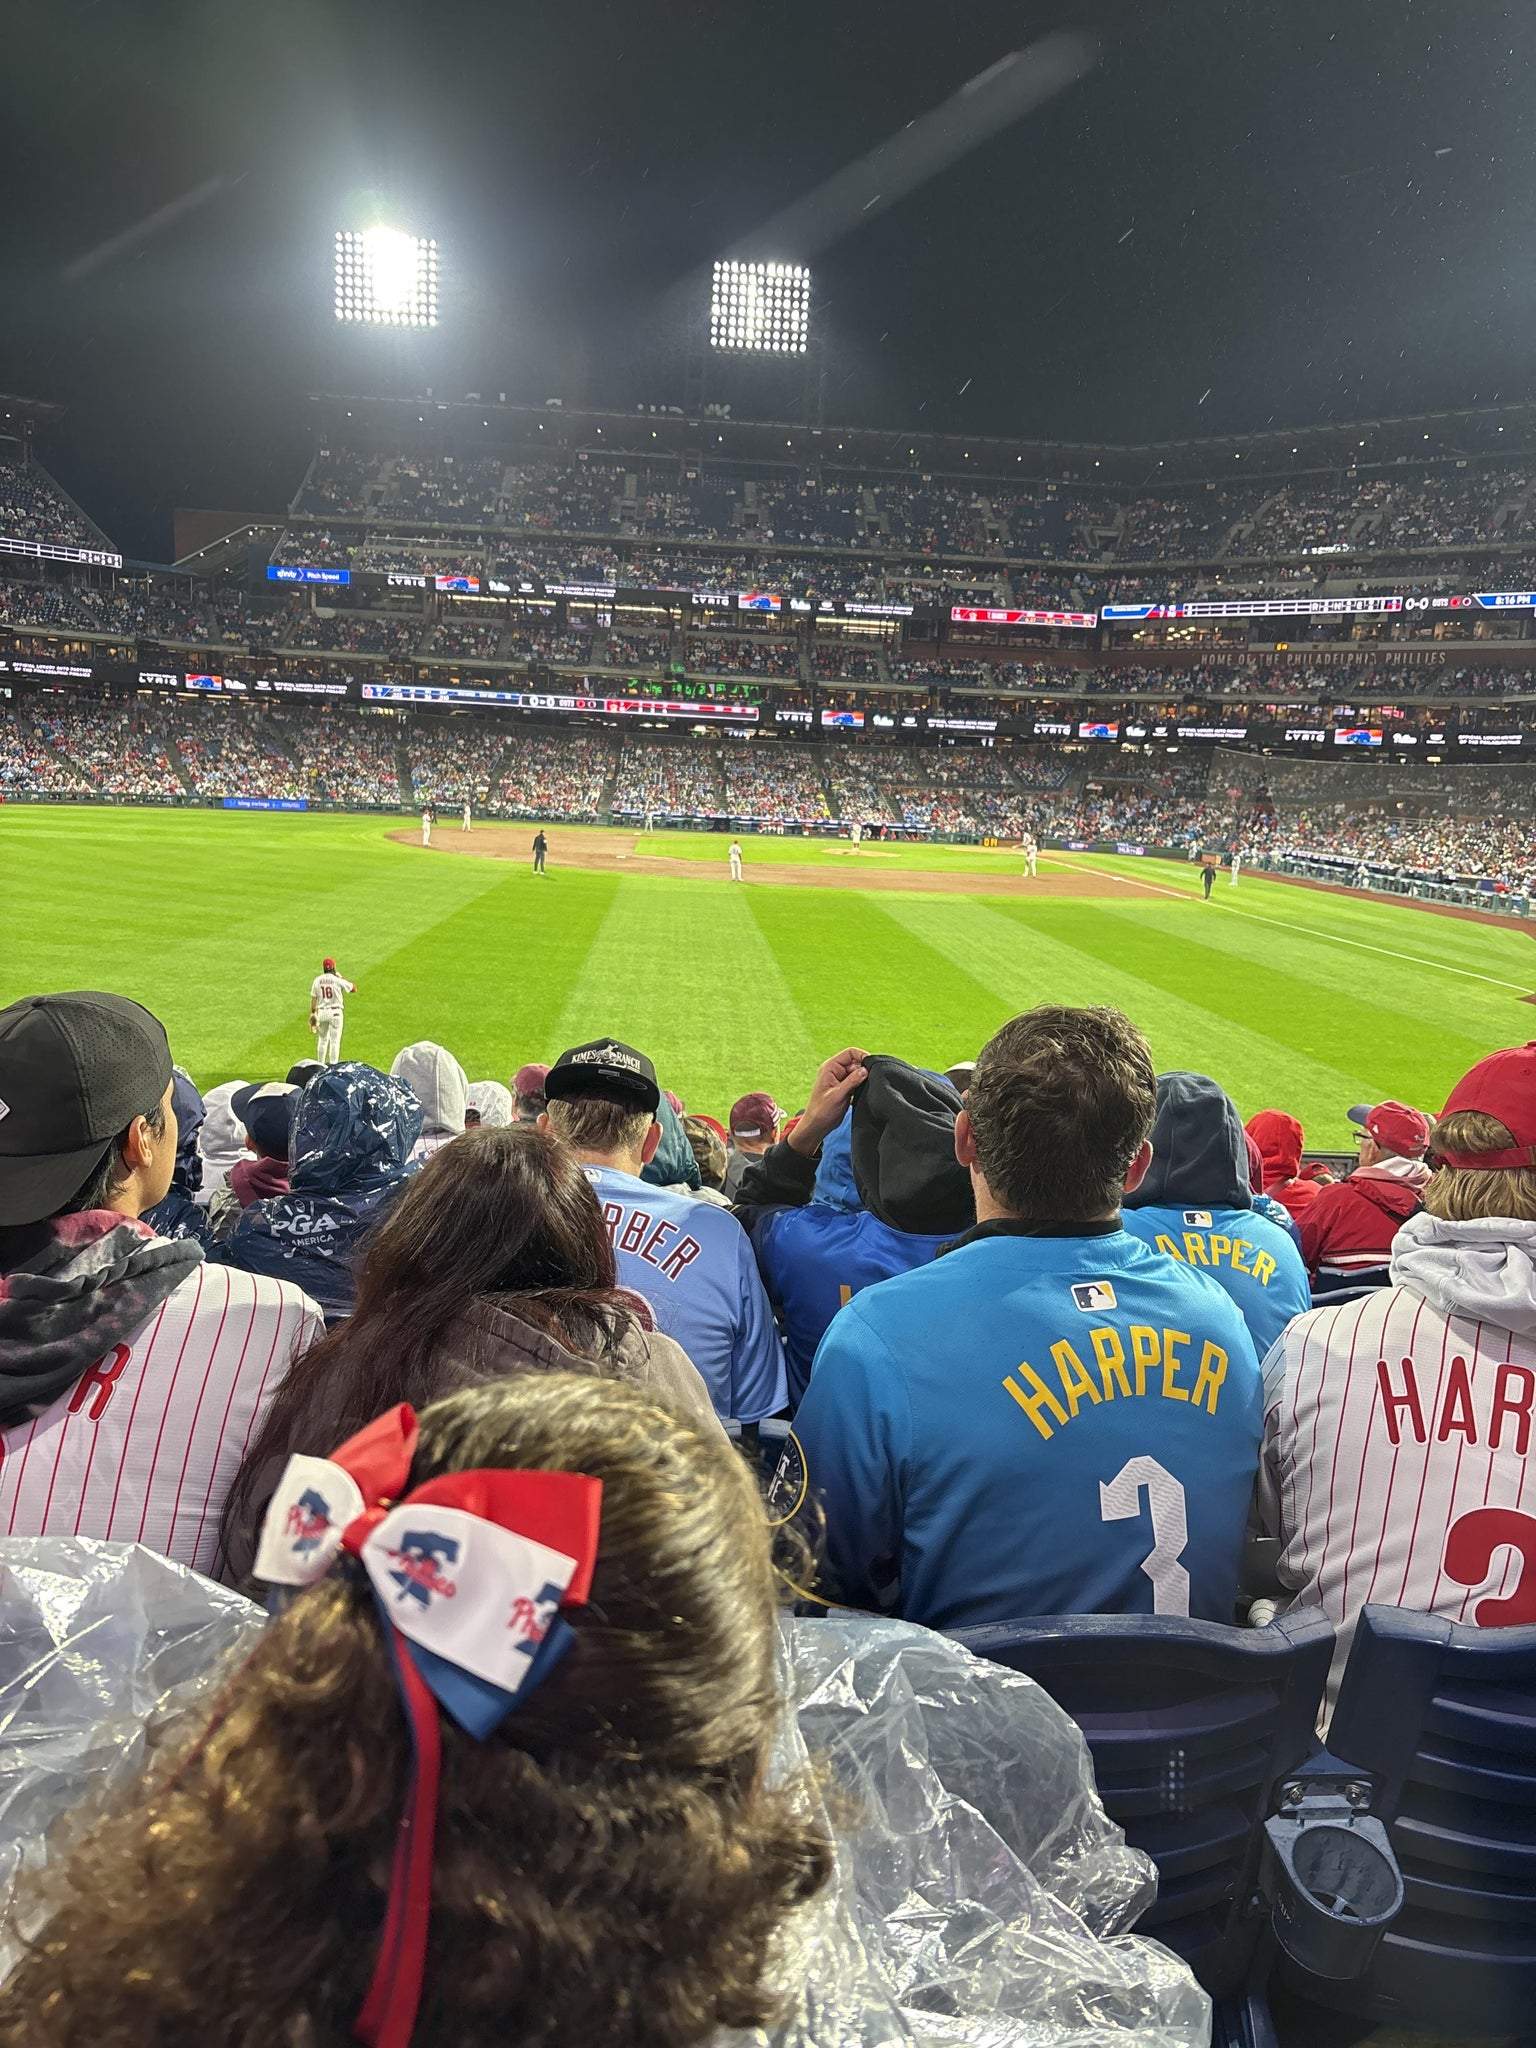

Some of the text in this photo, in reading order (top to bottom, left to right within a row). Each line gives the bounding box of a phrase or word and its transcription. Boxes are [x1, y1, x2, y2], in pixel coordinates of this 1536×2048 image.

[1405, 597, 1449, 610] 0-0 OUTS
[1495, 595, 1531, 605] 8:16 PM
[1201, 654, 1232, 666] HOME
[1239, 654, 1252, 665] OF
[1260, 653, 1280, 666] THE
[1385, 652, 1446, 665] PHILLIES
[529, 695, 555, 707] 0-0
[571, 1049, 641, 1070] KIMES RANCH
[270, 1213, 341, 1238] PGA
[291, 1234, 335, 1247] AMERICA
[66, 1342, 132, 1423] R
[1002, 1325, 1229, 1441] HARPER
[1376, 1355, 1536, 1458] HAR
[1099, 1454, 1191, 1618] 3
